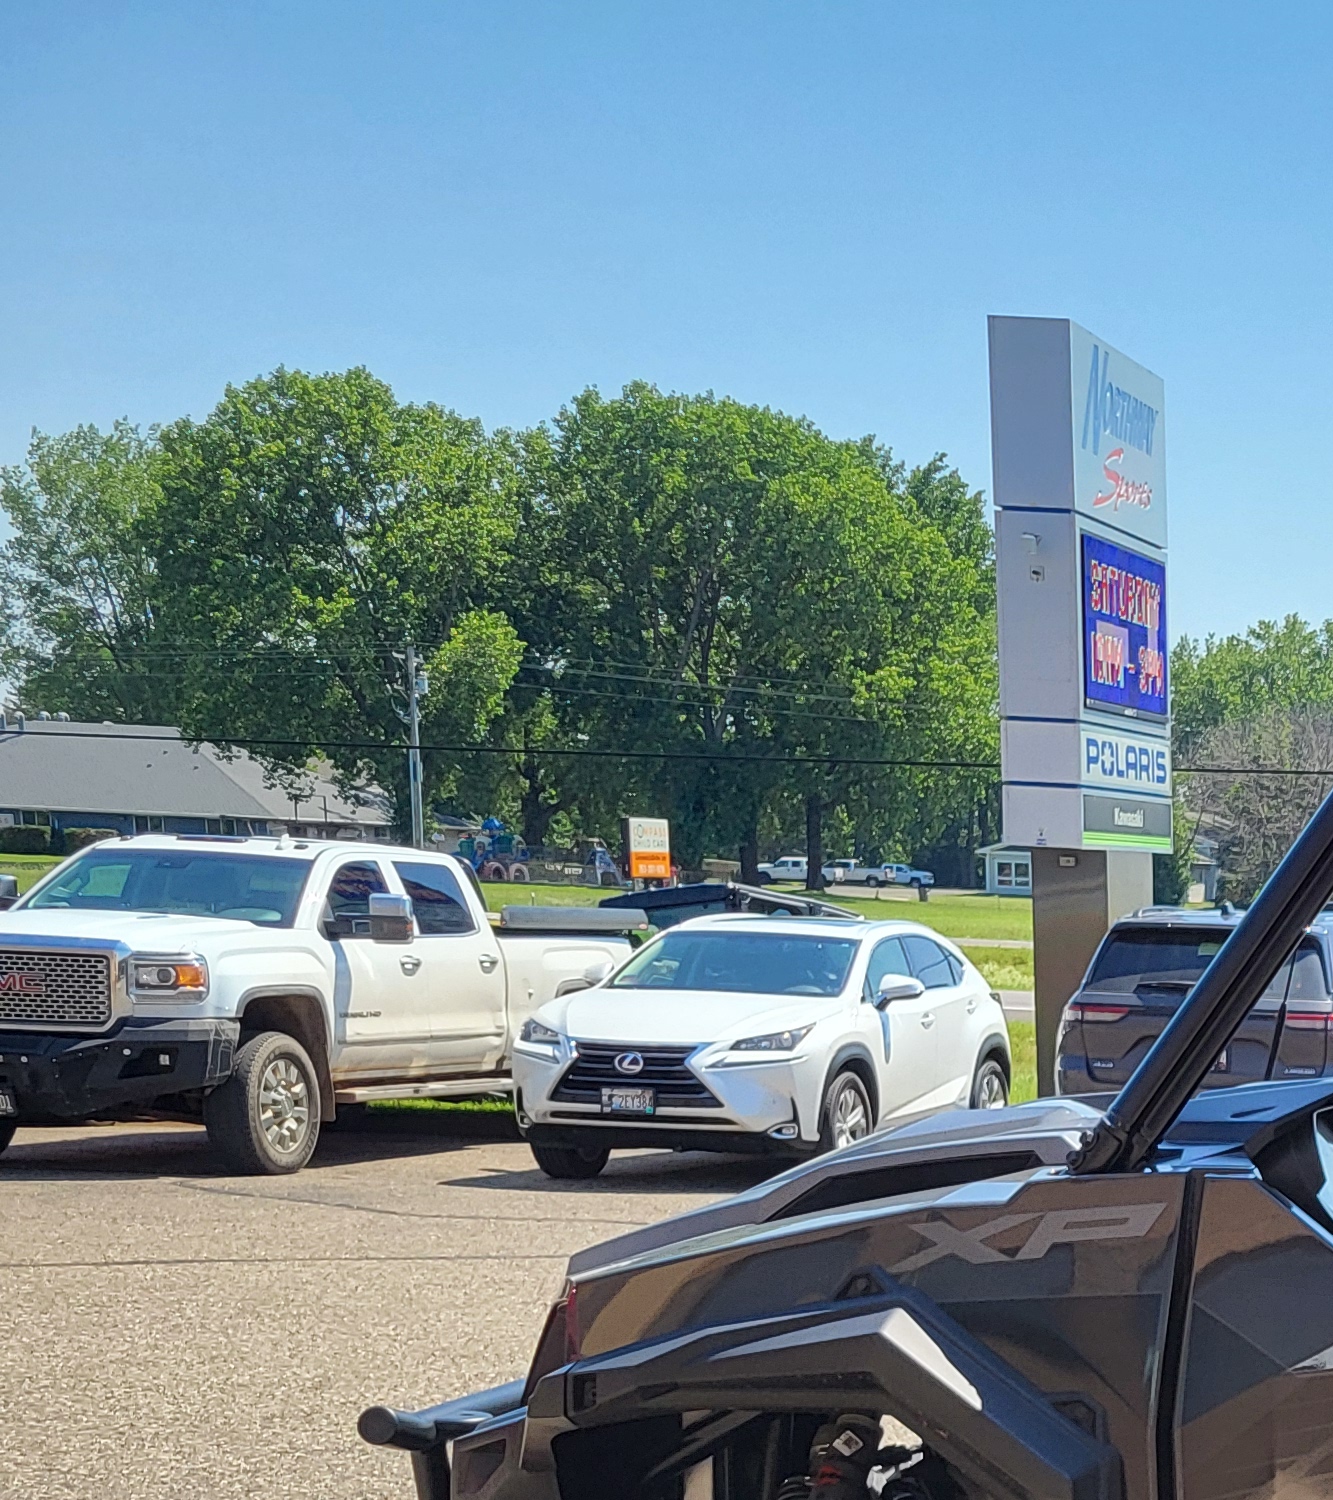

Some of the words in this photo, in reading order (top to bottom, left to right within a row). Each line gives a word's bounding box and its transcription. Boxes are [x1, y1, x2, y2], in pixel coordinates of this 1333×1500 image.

[1091, 560, 1160, 630] SATURDAY
[1086, 737, 1167, 785] POLARIS
[885, 1202, 1168, 1272] XP
